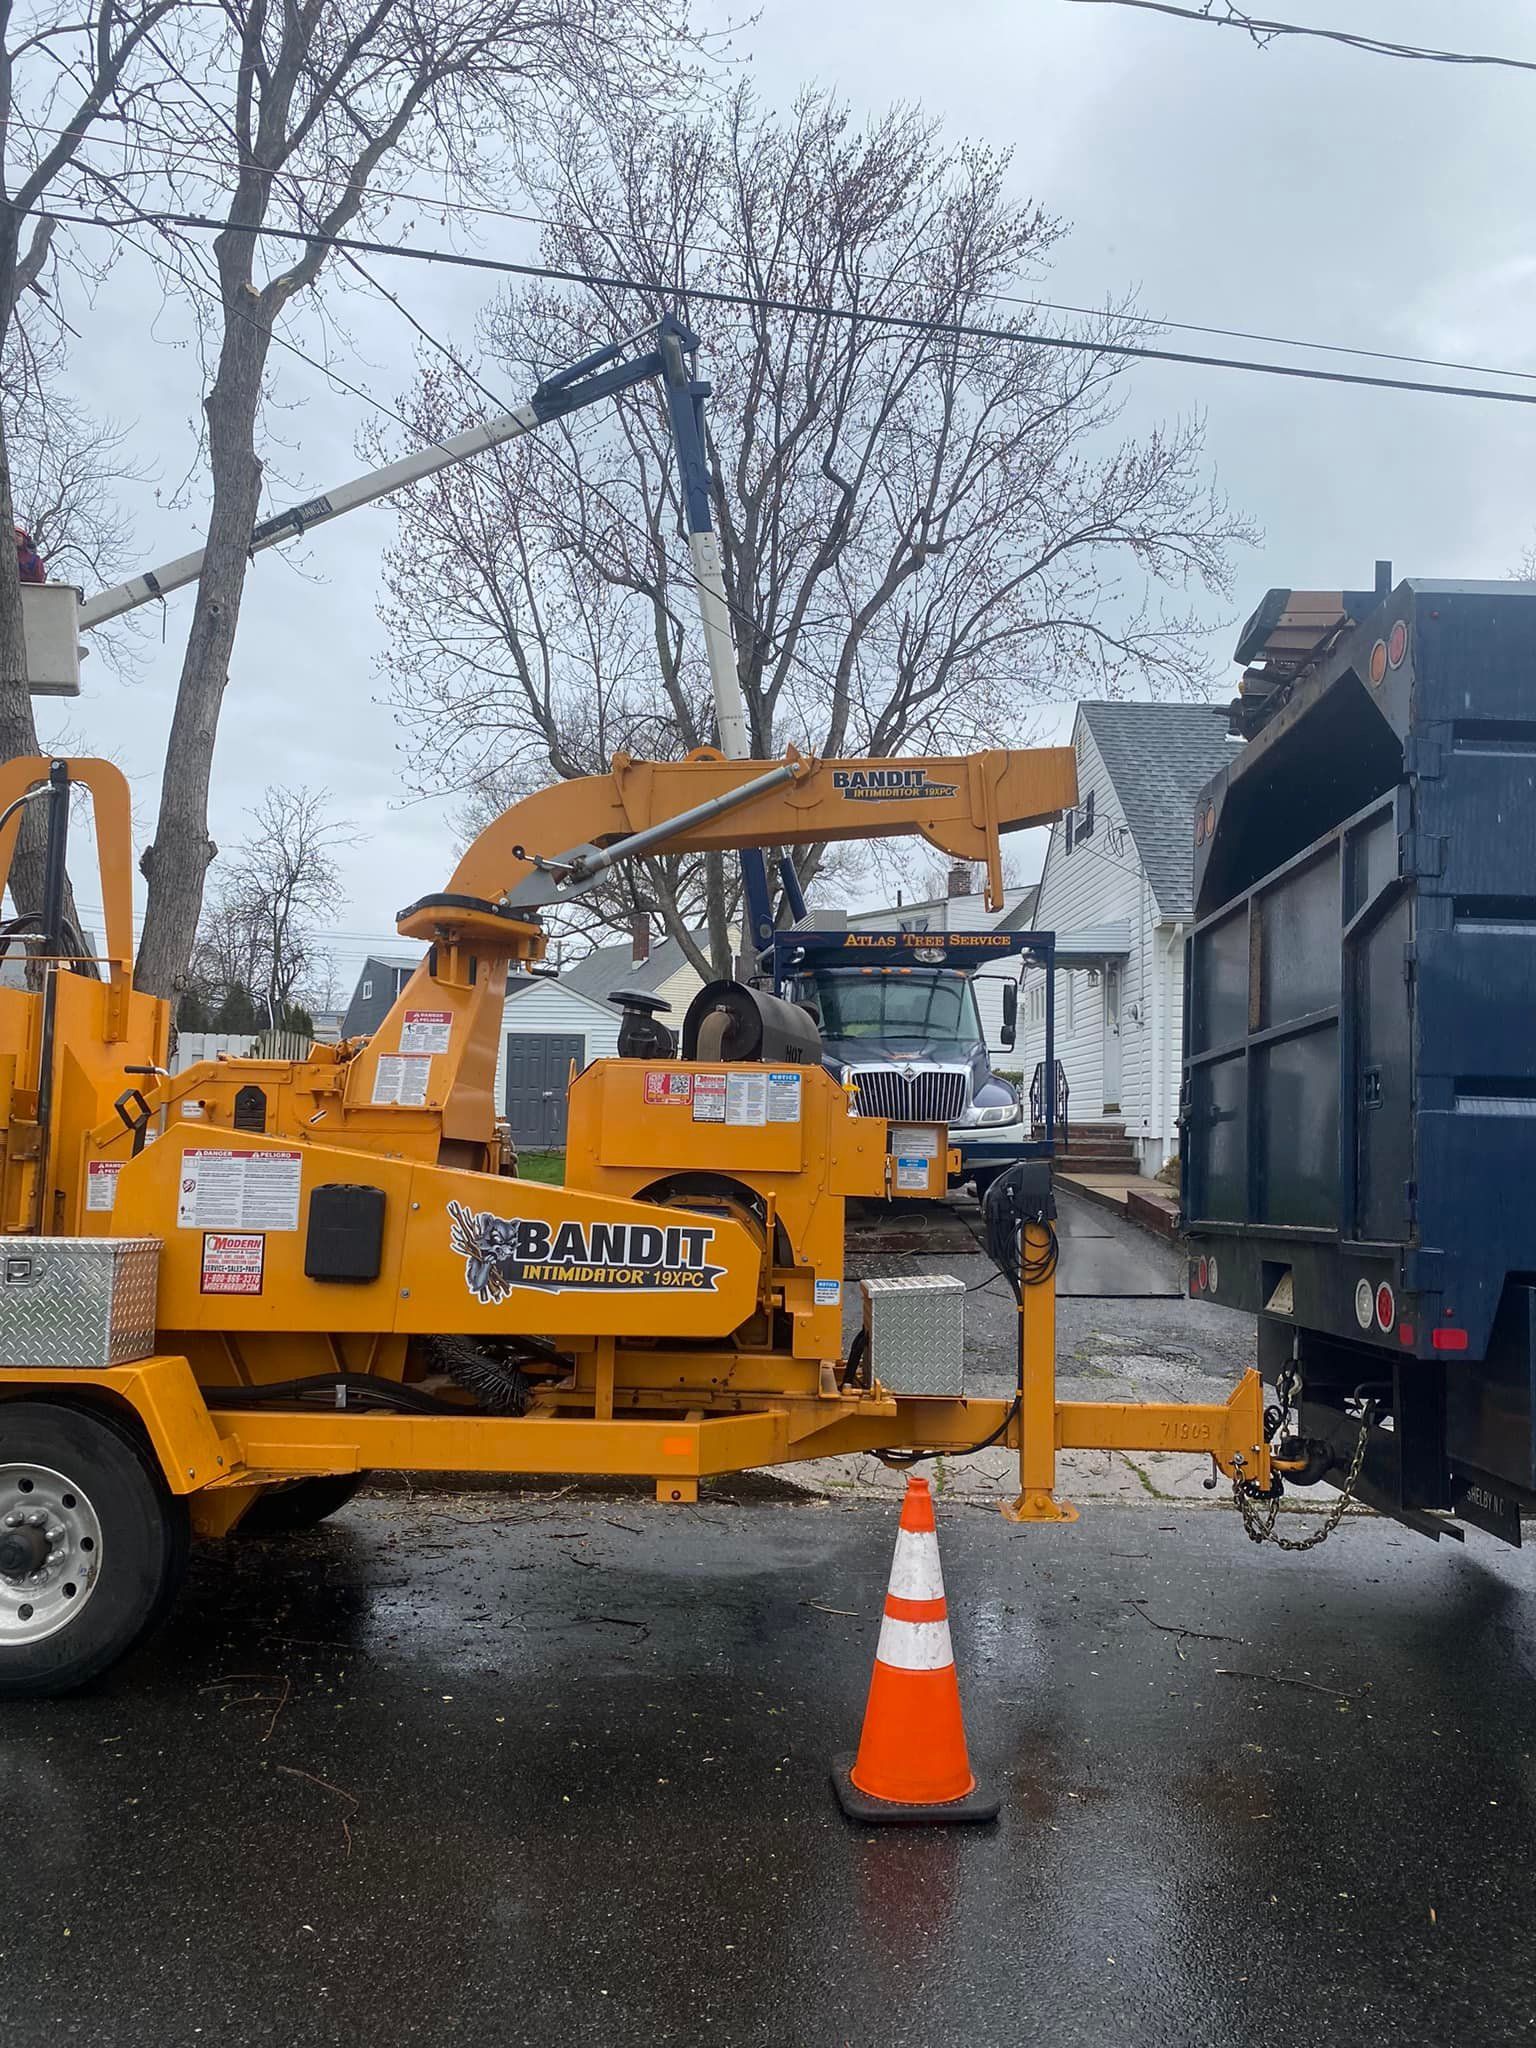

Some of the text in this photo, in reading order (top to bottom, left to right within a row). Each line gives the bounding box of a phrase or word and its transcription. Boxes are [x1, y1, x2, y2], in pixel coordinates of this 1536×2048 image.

[833, 770, 926, 788] BANDIT
[853, 787, 953, 798] INTIMIDATOR 19XPC
[844, 933, 1012, 947] ATLAS TREE SERVICE
[785, 1044, 803, 1064] HOT
[211, 1236, 262, 1250] MODERN
[516, 1221, 714, 1268] BANDIT
[653, 1271, 705, 1287] 19XPC
